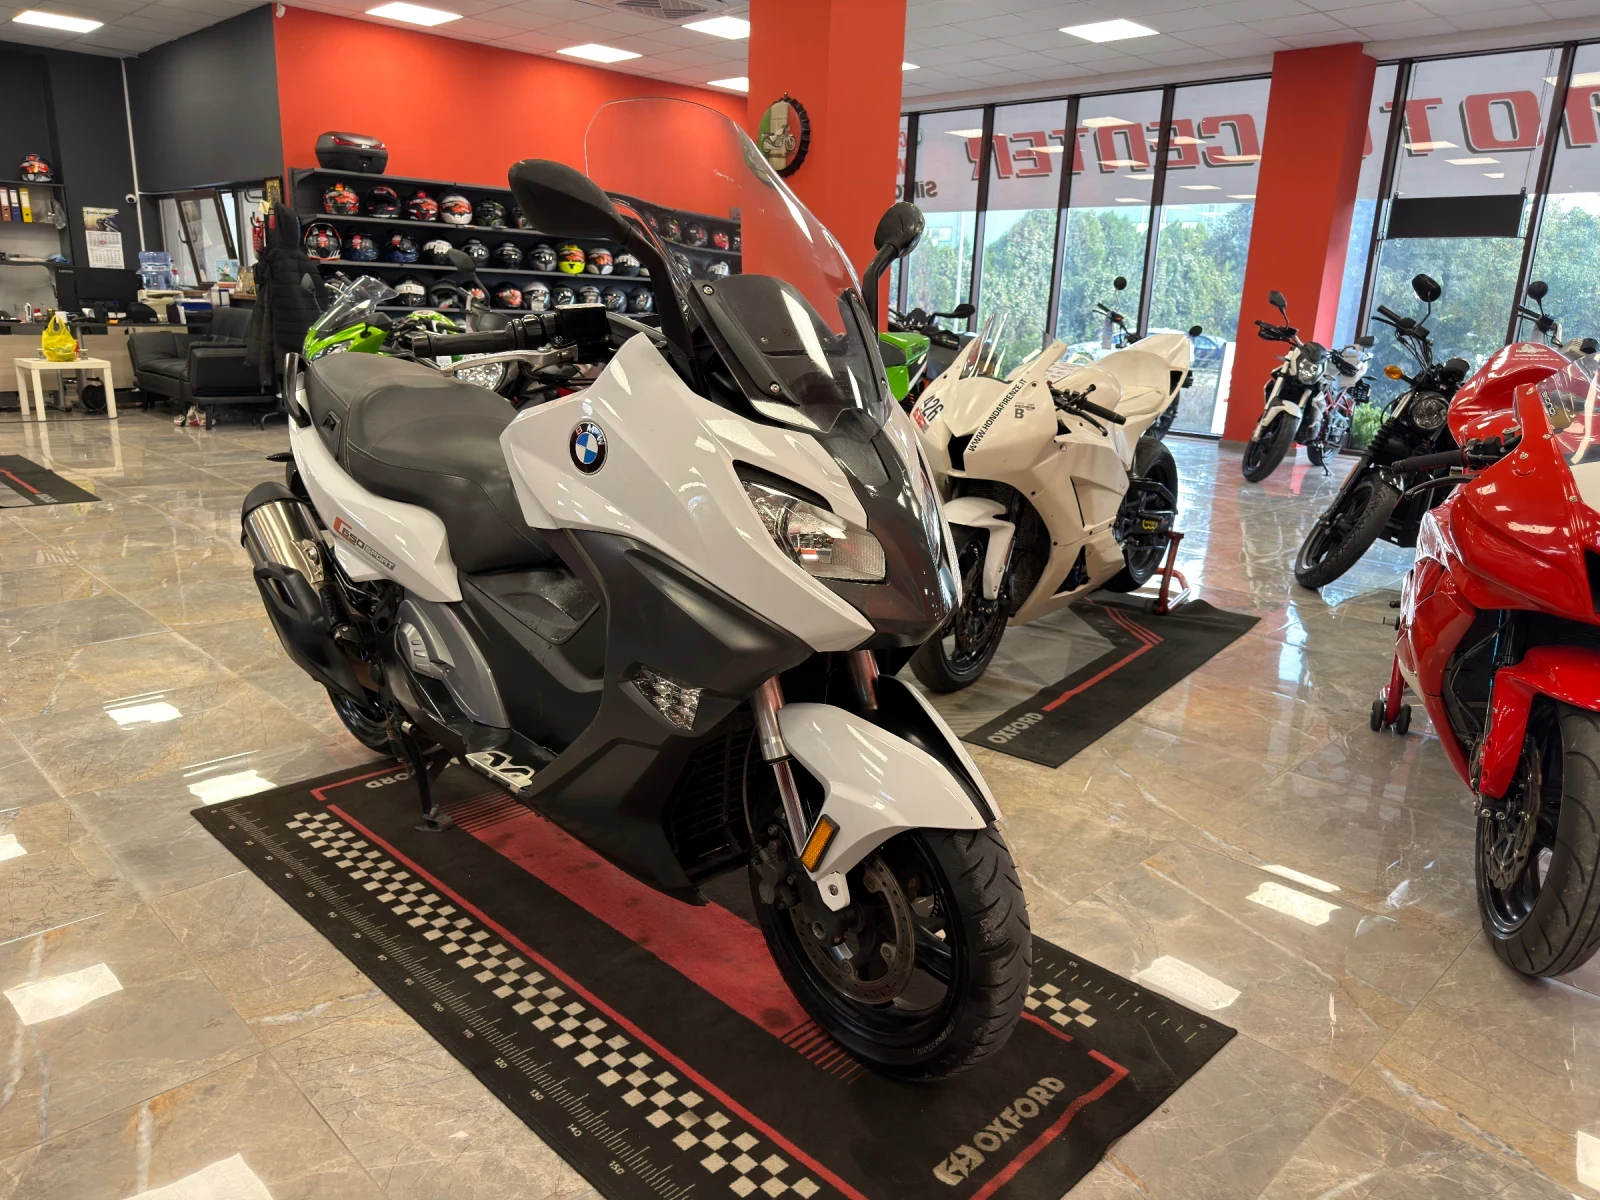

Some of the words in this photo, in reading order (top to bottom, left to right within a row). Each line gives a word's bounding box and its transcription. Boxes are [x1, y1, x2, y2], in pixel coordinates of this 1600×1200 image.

[922, 394, 944, 422] 426
[968, 378, 1027, 452] WWW.HONDAFIRENZE.IT
[333, 516, 365, 549] C650
[364, 544, 396, 571] SPORT
[987, 712, 1044, 744] OXFORD
[432, 1002, 445, 1013] 100
[462, 1029, 475, 1039] 110
[493, 1058, 508, 1069] 120
[529, 1089, 545, 1101] 130
[566, 1123, 583, 1138] 140
[608, 1160, 626, 1176] 150
[973, 1077, 1066, 1153] OXFORD
